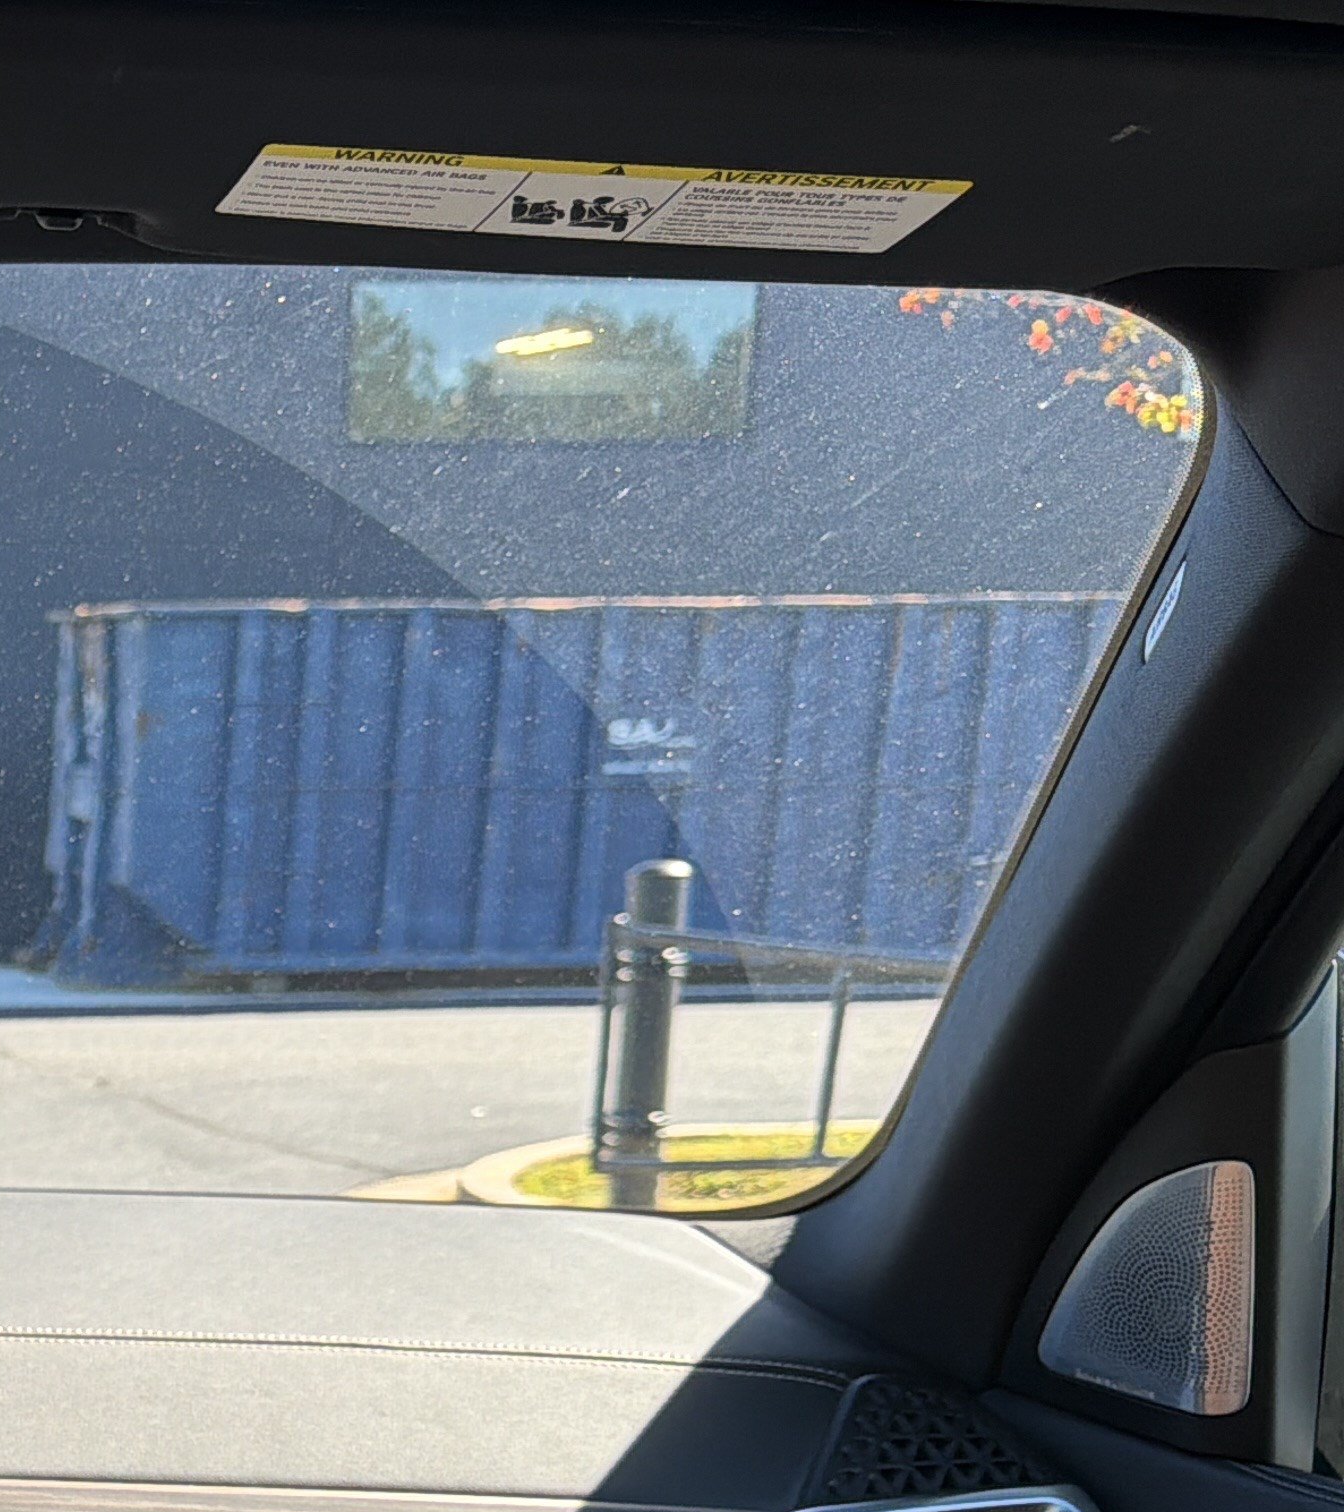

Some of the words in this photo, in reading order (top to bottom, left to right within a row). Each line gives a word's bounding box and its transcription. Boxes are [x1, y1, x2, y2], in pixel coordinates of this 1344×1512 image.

[334, 149, 464, 167] WARNING
[263, 160, 300, 169] EVEN
[303, 162, 340, 172] WITH
[343, 165, 420, 176] ADVANCED
[420, 170, 447, 178] AIR
[450, 172, 488, 181] BAGS
[701, 170, 935, 192] AVERTISSEMENT
[692, 186, 753, 197] VALABLE
[755, 189, 795, 199] POUR
[799, 191, 839, 200] TOUS
[840, 193, 884, 202] TYPES
[886, 195, 908, 203] DE
